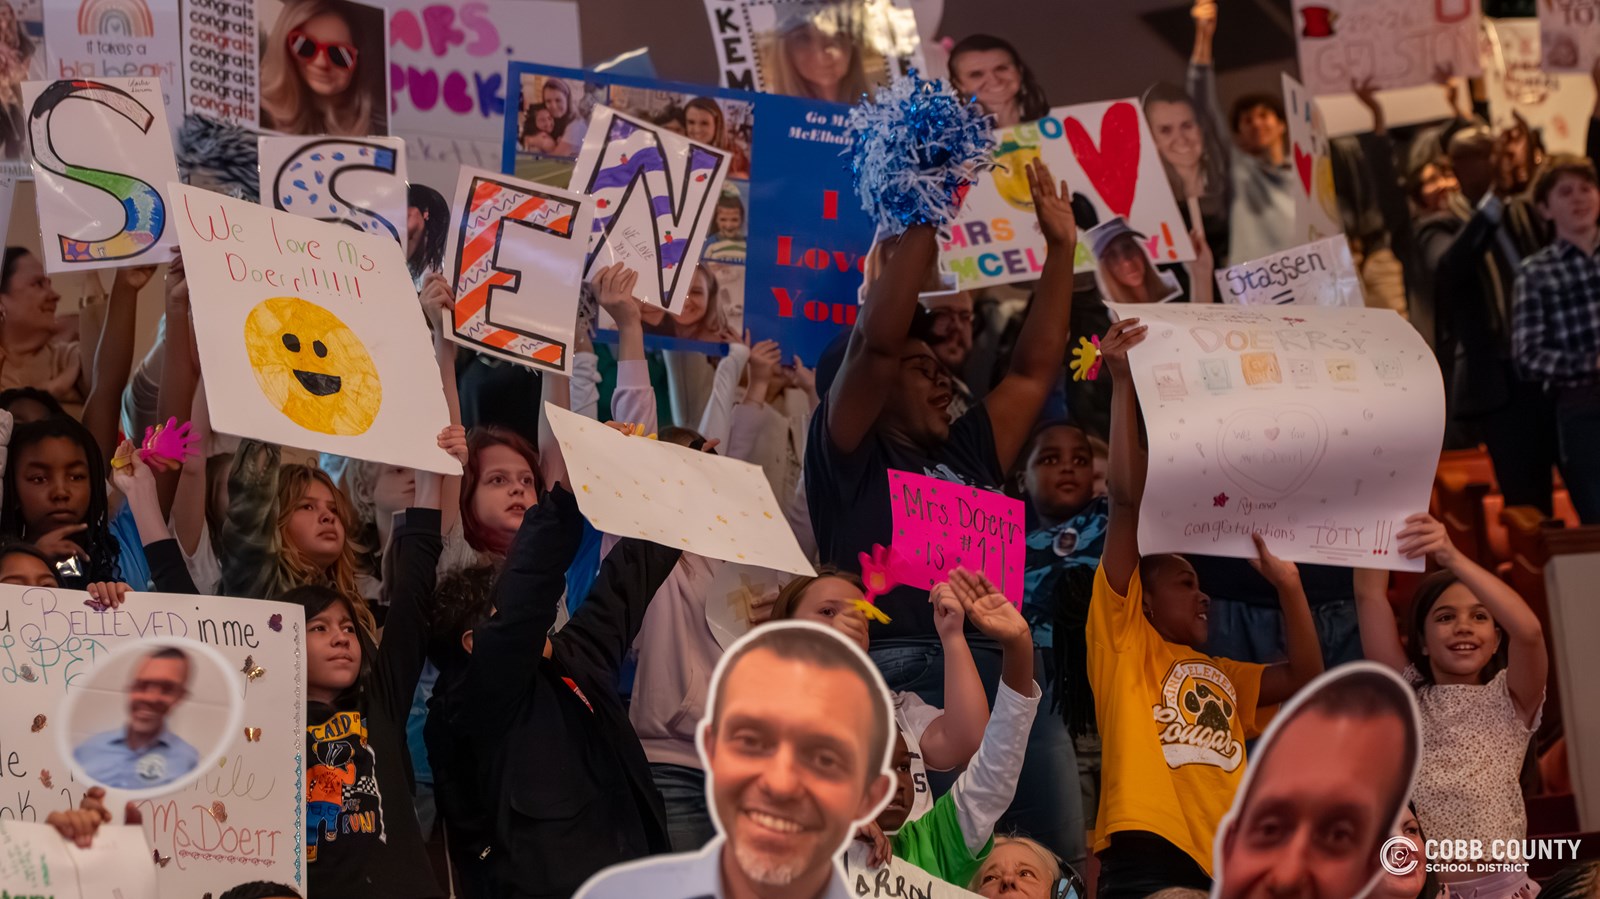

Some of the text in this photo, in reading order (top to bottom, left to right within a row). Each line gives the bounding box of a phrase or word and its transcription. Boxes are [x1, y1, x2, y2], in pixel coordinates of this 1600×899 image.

[189, 11, 254, 37] congrats
[97, 40, 132, 56] takes
[189, 28, 254, 54] congrats
[189, 44, 254, 70] congrats
[189, 61, 254, 87] congrats
[190, 77, 254, 103] congrats
[190, 94, 254, 121] congrats
[805, 111, 827, 125] Go
[1012, 117, 1063, 144] GO
[28, 80, 165, 262] S
[583, 114, 724, 310] N
[823, 190, 838, 220] I
[184, 194, 245, 241] We
[271, 217, 320, 259] love
[942, 218, 1015, 252] MRS
[453, 176, 581, 371] E
[1225, 252, 1326, 295] Stassen
[956, 497, 1023, 544] Doerr
[196, 606, 219, 646] in
[222, 619, 260, 648] me
[192, 805, 281, 856] Doerr
